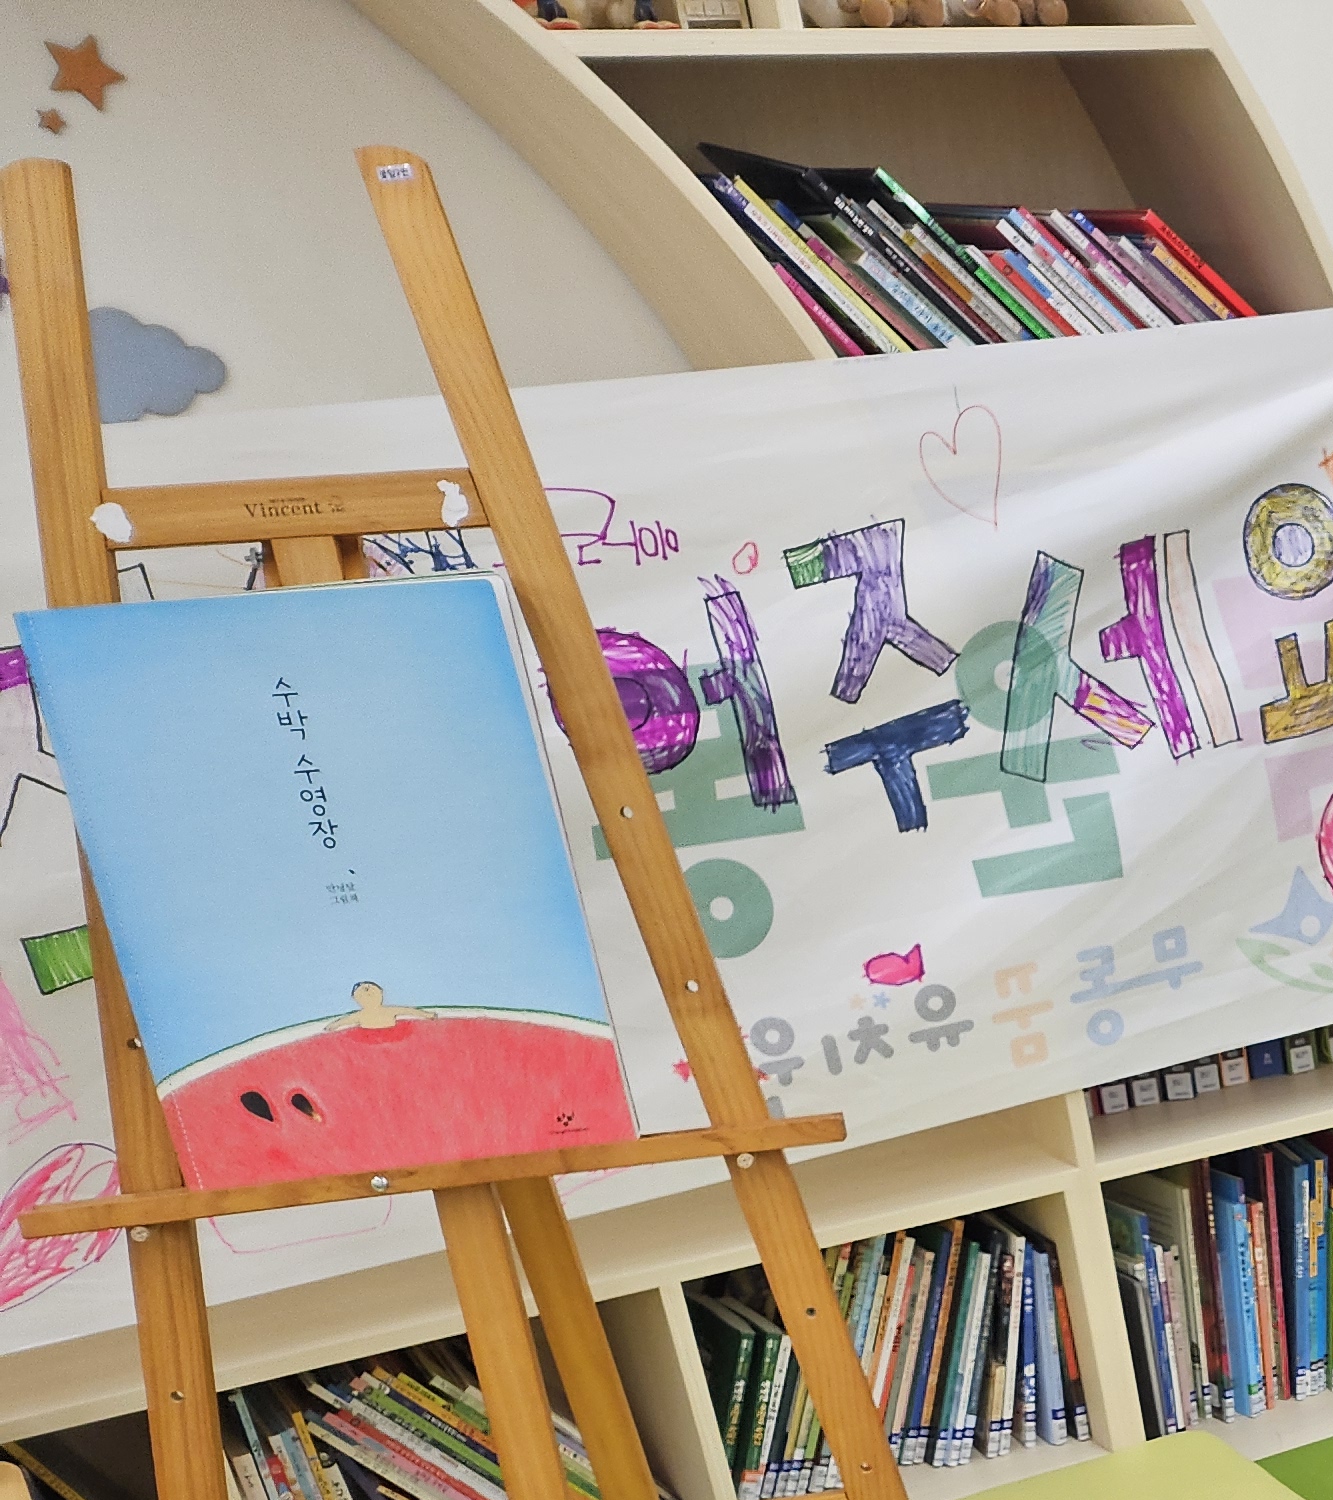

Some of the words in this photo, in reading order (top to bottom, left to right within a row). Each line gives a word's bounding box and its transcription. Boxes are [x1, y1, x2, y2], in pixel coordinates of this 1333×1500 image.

[244, 501, 322, 518] Vincent
[271, 677, 309, 740] 수박
[294, 753, 339, 850] 수영장
